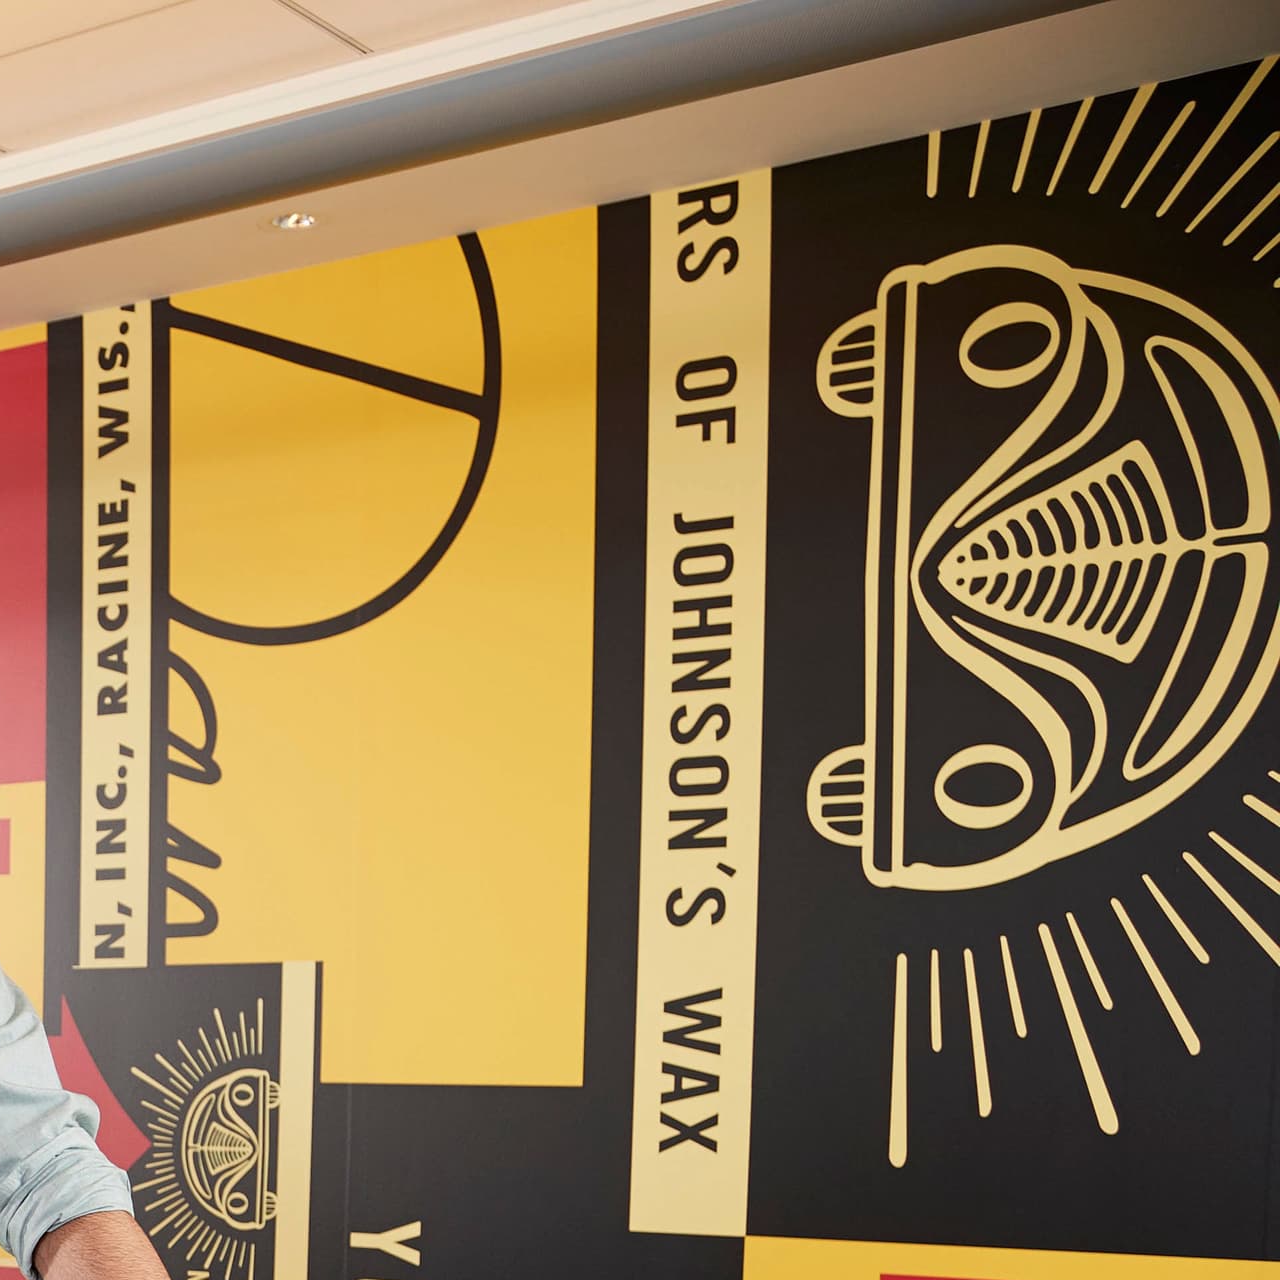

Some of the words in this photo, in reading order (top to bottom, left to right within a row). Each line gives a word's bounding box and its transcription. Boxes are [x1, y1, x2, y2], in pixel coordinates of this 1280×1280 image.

[674, 354, 739, 445] OF
[95, 478, 137, 716] RACINE,
[665, 512, 738, 927] JOHNSON'S
[94, 742, 136, 882] INC.,
[657, 986, 724, 1154] WAX
